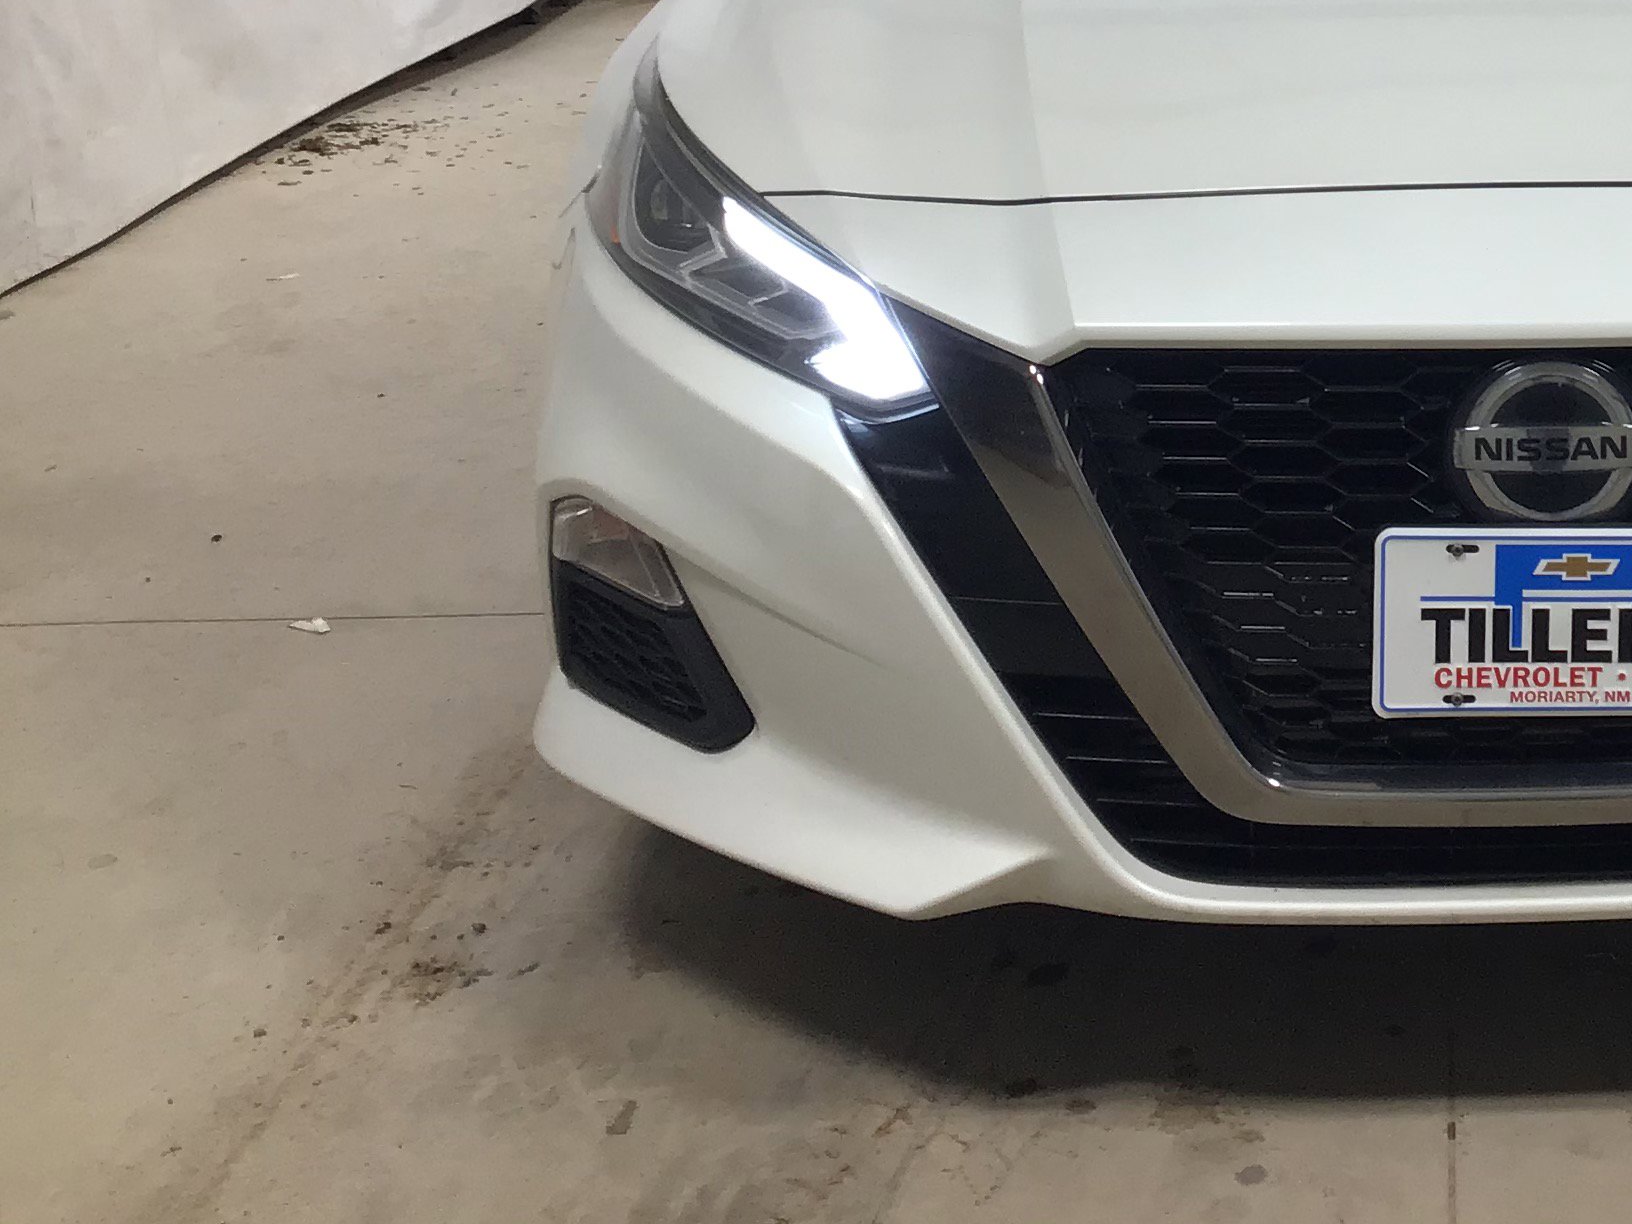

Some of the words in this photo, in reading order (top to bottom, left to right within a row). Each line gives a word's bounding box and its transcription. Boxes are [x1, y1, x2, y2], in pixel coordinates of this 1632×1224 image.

[1474, 435, 1628, 462] NISSAN
[1434, 666, 1604, 689] CHEVROLET
[1509, 690, 1599, 704] MORIARTY,
[1604, 690, 1631, 703] NM
